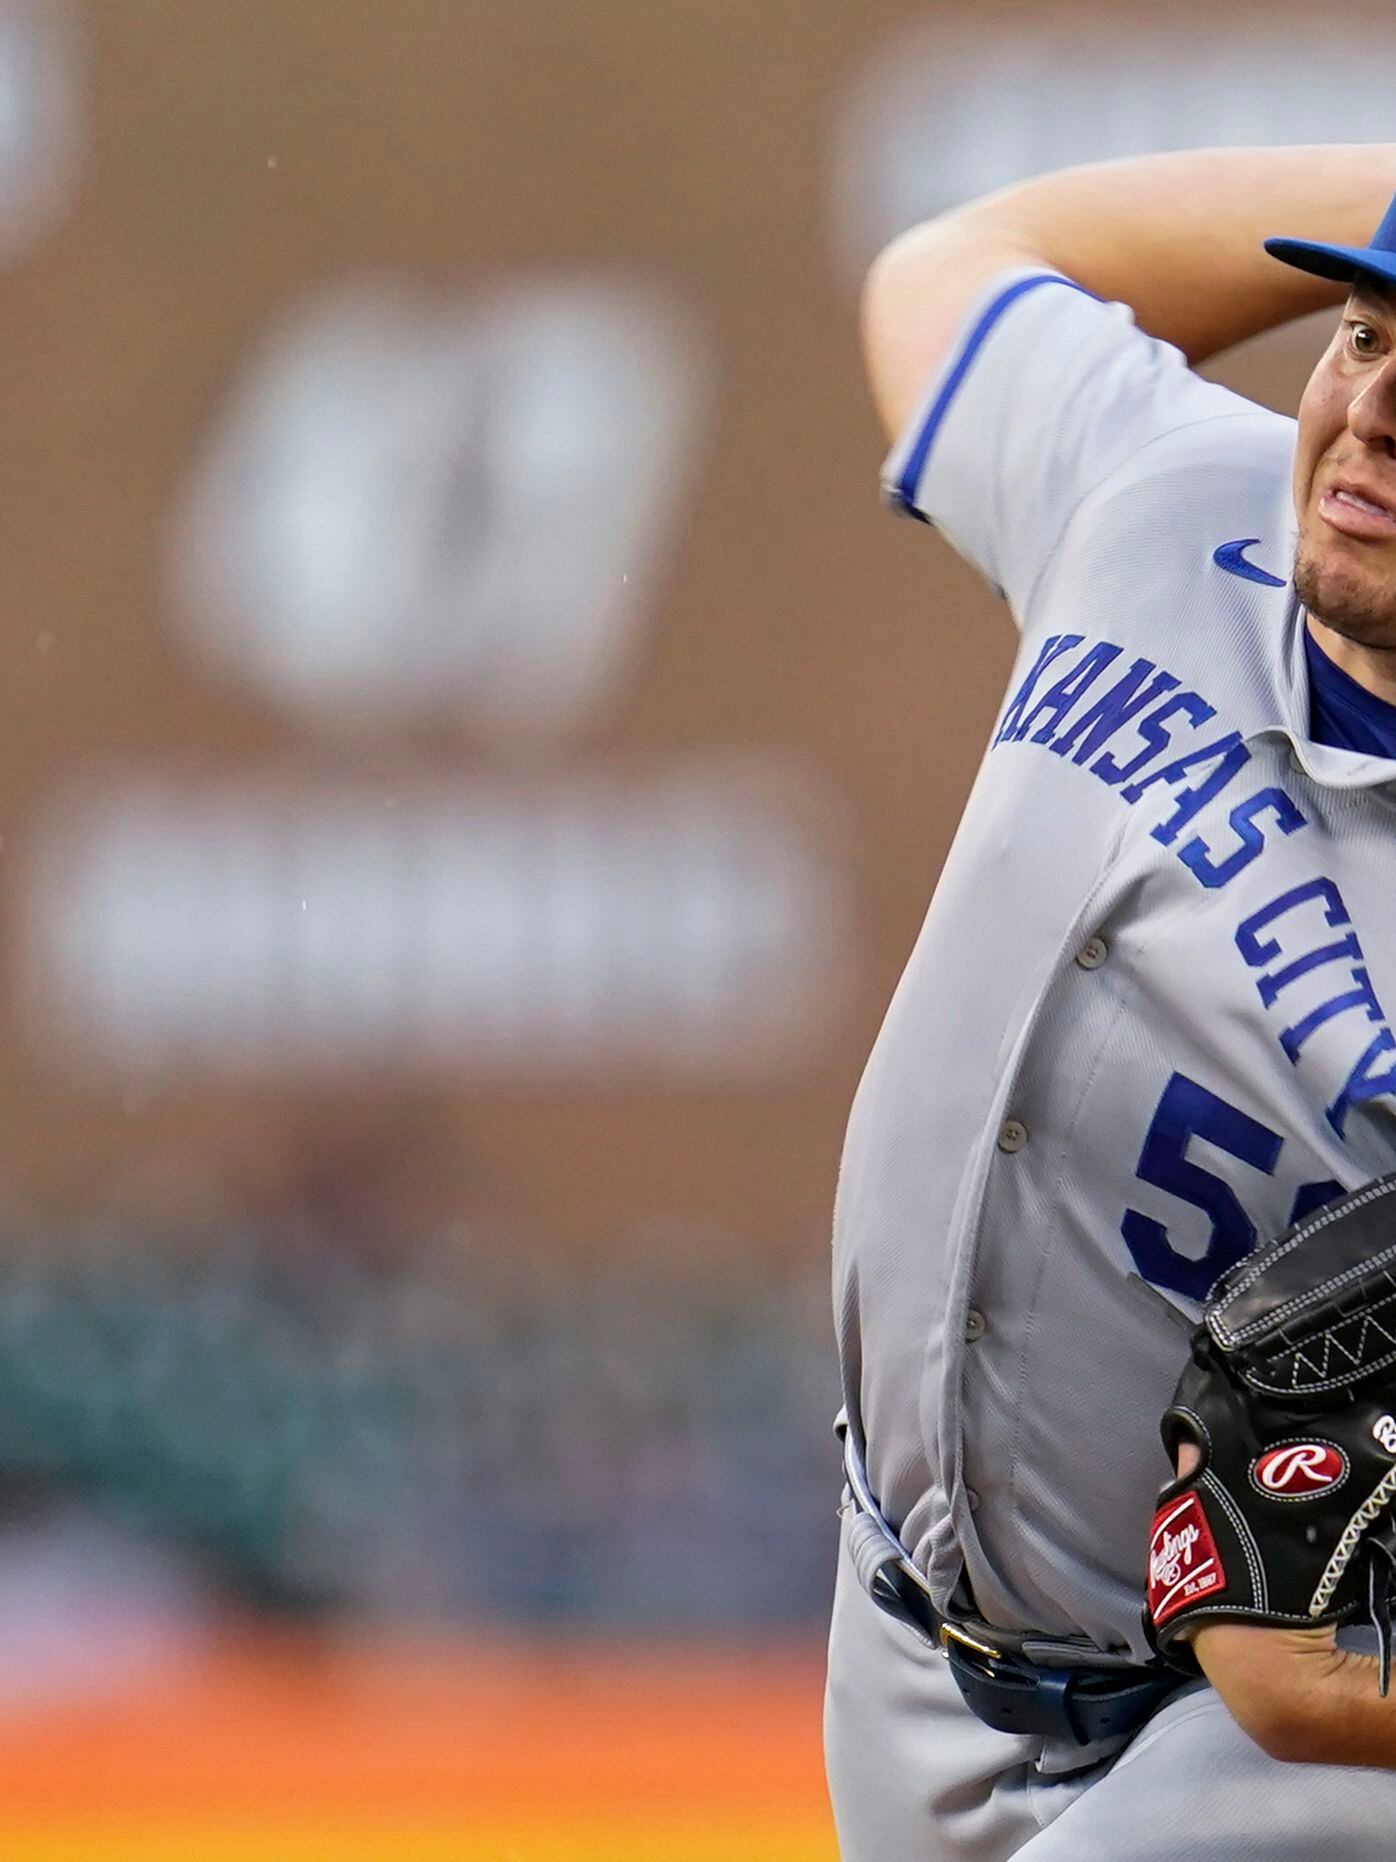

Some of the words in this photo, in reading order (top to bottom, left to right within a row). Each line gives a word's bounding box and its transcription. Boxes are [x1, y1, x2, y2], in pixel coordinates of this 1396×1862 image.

[992, 633, 1307, 889] KANSAS
[1120, 1070, 1350, 1301] 5
[1261, 1444, 1333, 1491] R
